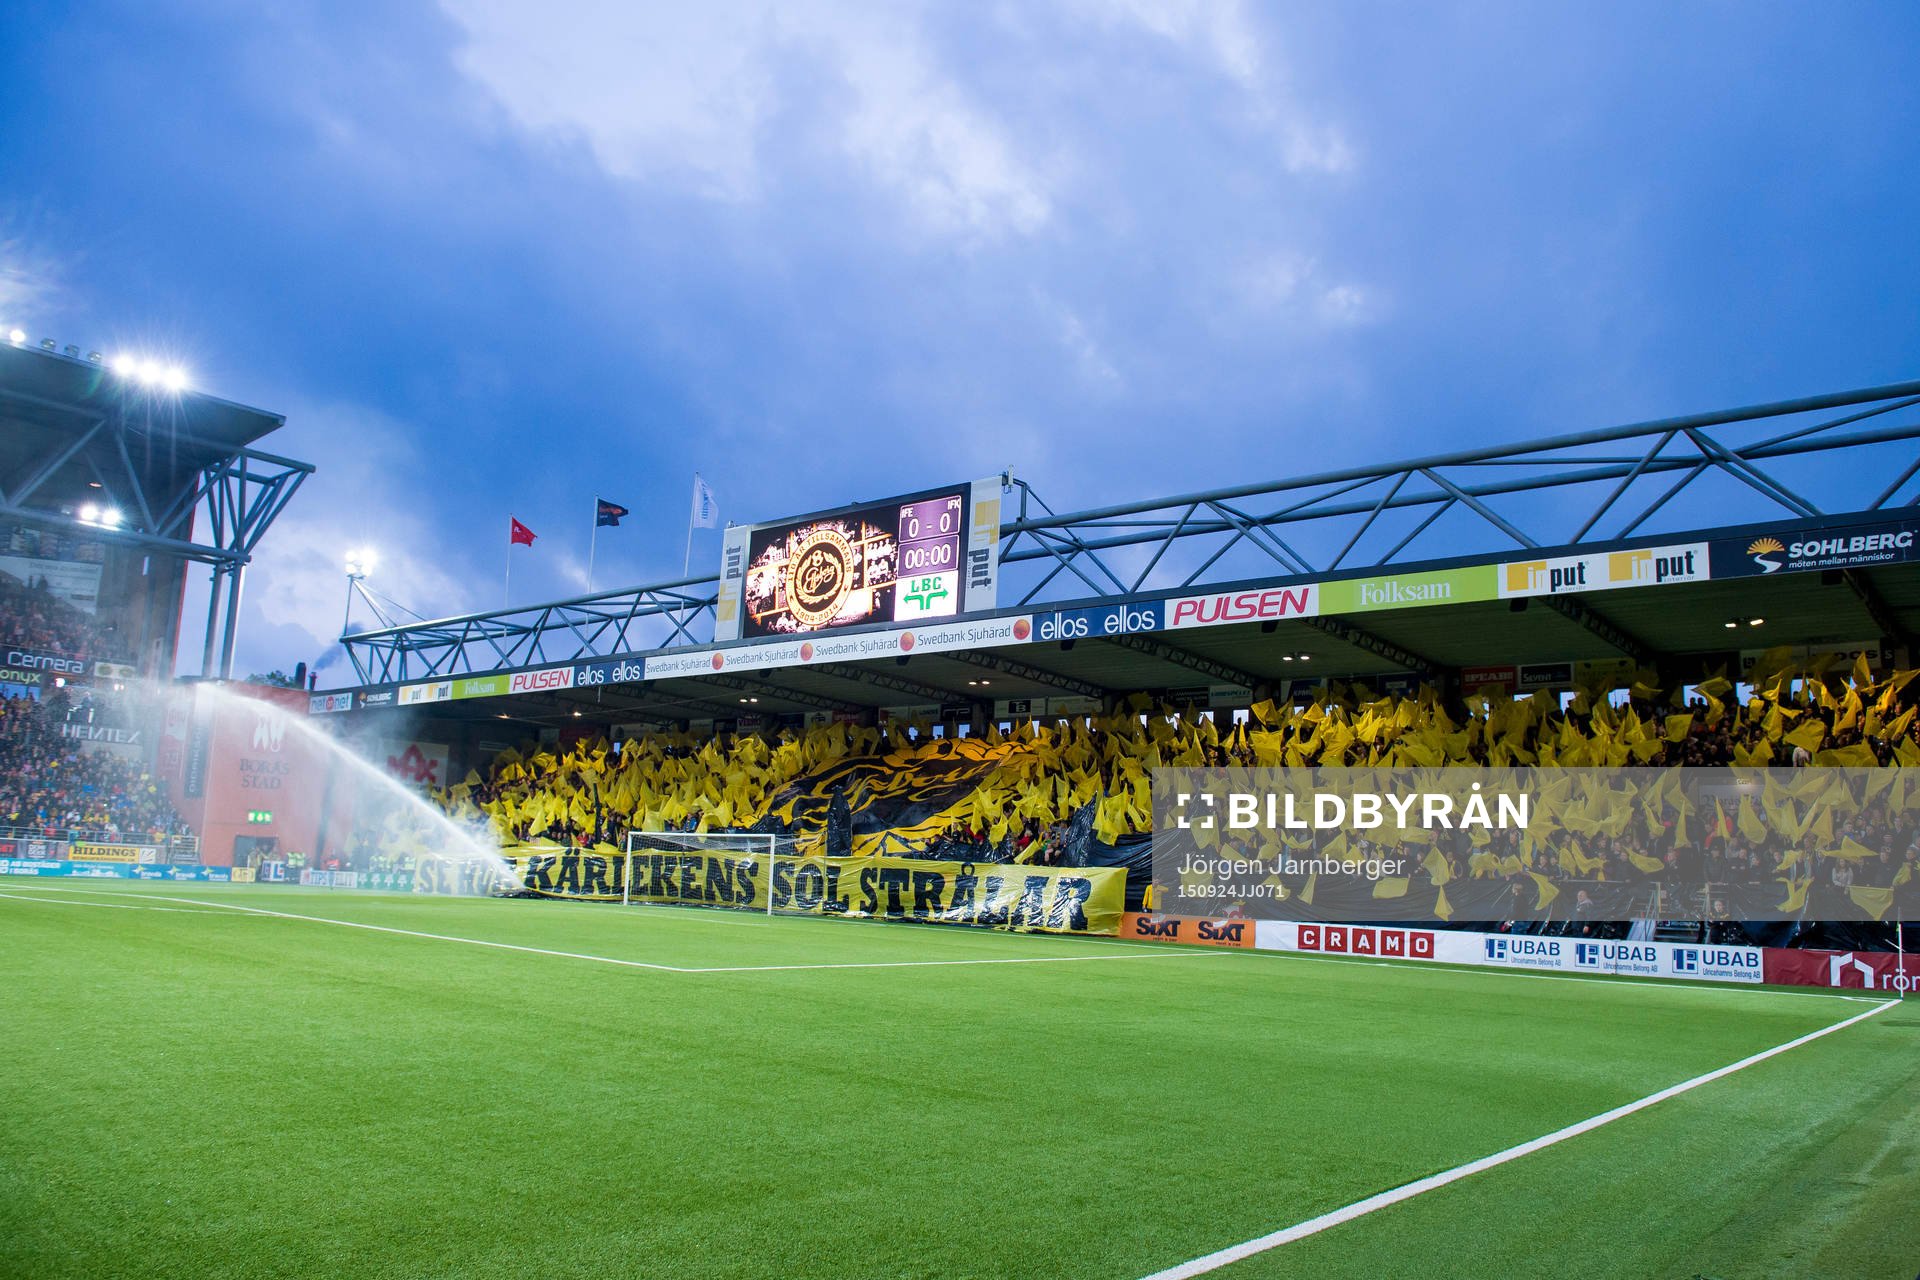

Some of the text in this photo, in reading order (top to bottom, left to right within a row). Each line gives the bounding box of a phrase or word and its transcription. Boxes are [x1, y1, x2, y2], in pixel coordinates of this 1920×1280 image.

[908, 518, 920, 538] 0
[939, 512, 951, 533] 0
[1788, 531, 1913, 558] SOHLBERG
[904, 543, 951, 570] 00:00
[1788, 552, 1895, 568] möten mellan människor
[911, 576, 942, 593] LBC
[1360, 581, 1451, 606] Folksam
[1173, 588, 1309, 626] PULSEN
[1040, 612, 1088, 640] ellos
[1104, 605, 1156, 634] ellos
[918, 625, 1011, 646] Swedbank Sjuhärad
[726, 648, 799, 666] Swedbank Sjuhärad
[816, 638, 898, 657] Swedbank Sjuhärad
[577, 665, 605, 686] ellos
[612, 660, 641, 682] ellos
[646, 659, 680, 674] Swedbank
[512, 669, 571, 692] PULSEN
[524, 847, 759, 905] KÄRLEKENS
[772, 861, 849, 912] SOL
[859, 861, 1093, 930] STRÅLAR
[1303, 930, 1429, 953] CRAMO
[1511, 939, 1561, 956] UBAB
[1603, 945, 1657, 961] UBAB
[1702, 950, 1759, 968] UBAB
